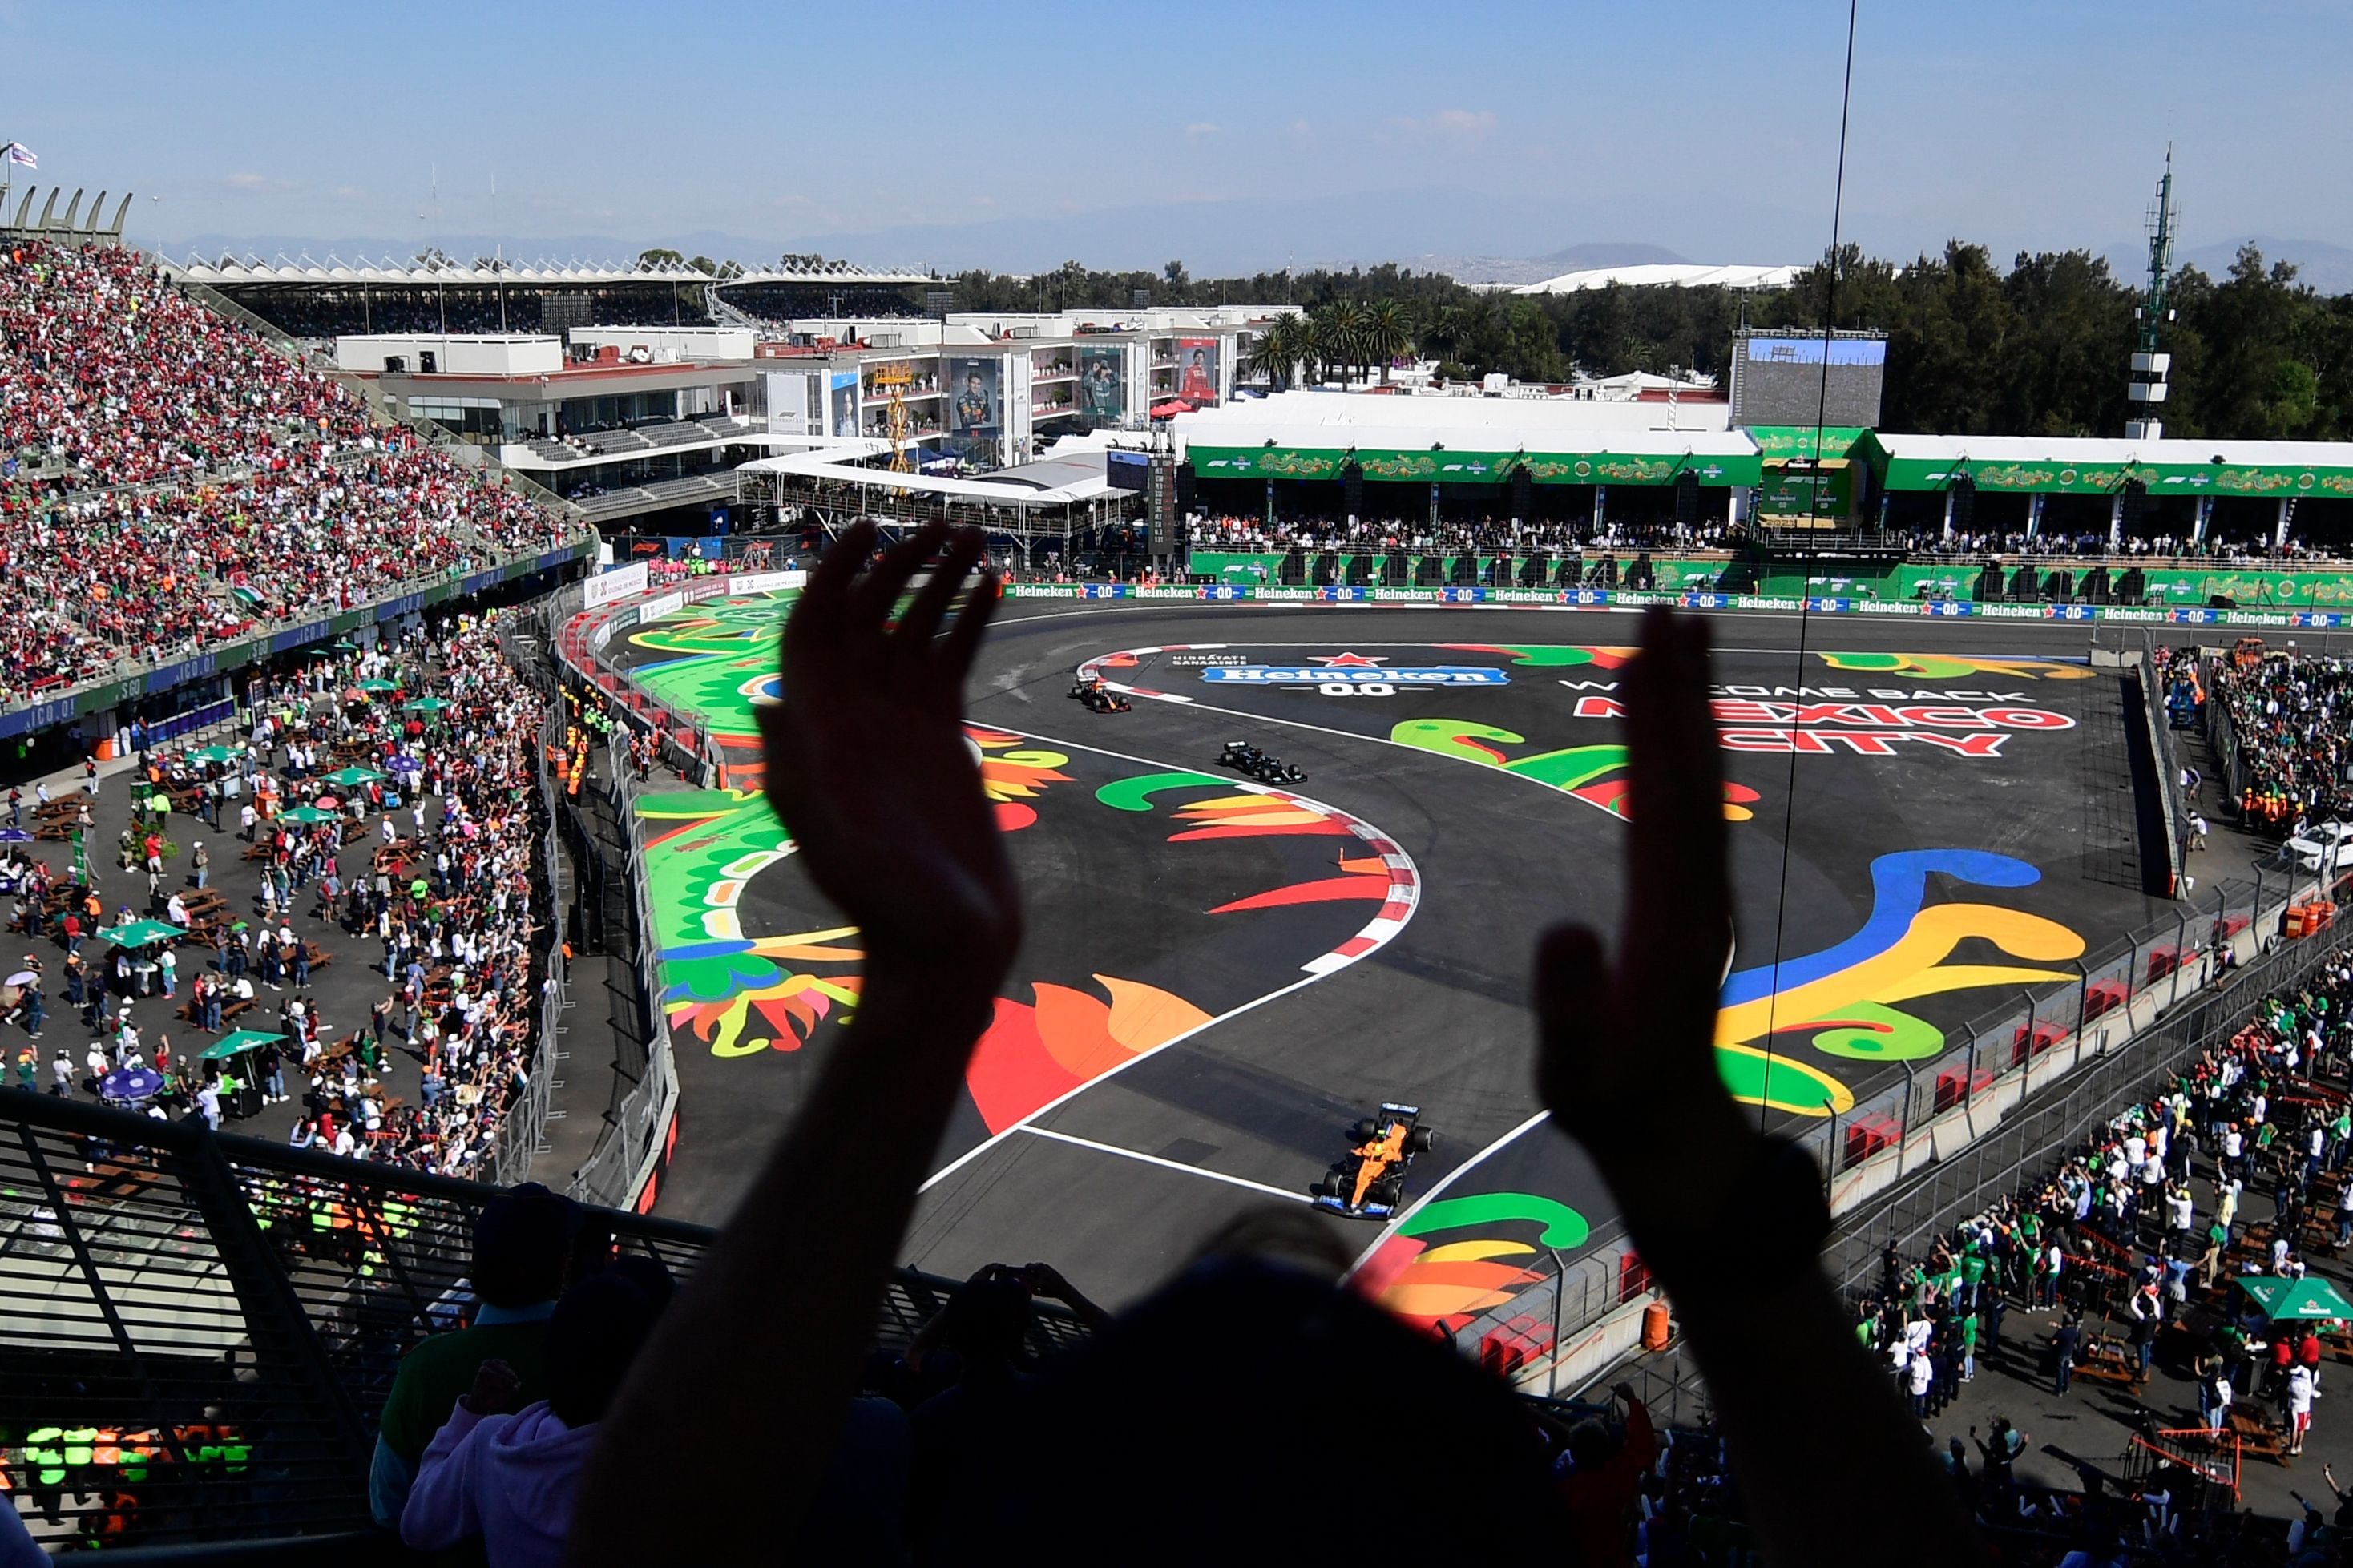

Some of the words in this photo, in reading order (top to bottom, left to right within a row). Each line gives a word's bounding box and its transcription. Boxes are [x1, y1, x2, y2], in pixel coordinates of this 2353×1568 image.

[1015, 585, 1074, 598] Heineken
[1136, 586, 1194, 598] Heineken
[1254, 586, 1313, 599] Heineken
[1374, 587, 1433, 600] Heineken
[1495, 590, 1554, 602] Heineken
[1616, 593, 1675, 606] Heineken
[1738, 596, 1796, 610] Heineken
[1860, 599, 1919, 614] Heineken
[1982, 603, 2040, 617] Heineken
[2105, 607, 2163, 621] Heineken
[2226, 612, 2285, 625] Heineken
[1221, 668, 1490, 683] Heineken
[1318, 683, 1398, 697] 0.0
[1558, 680, 1861, 699] WOME
[1866, 687, 2036, 703] BACK
[1716, 727, 2012, 757] CITY
